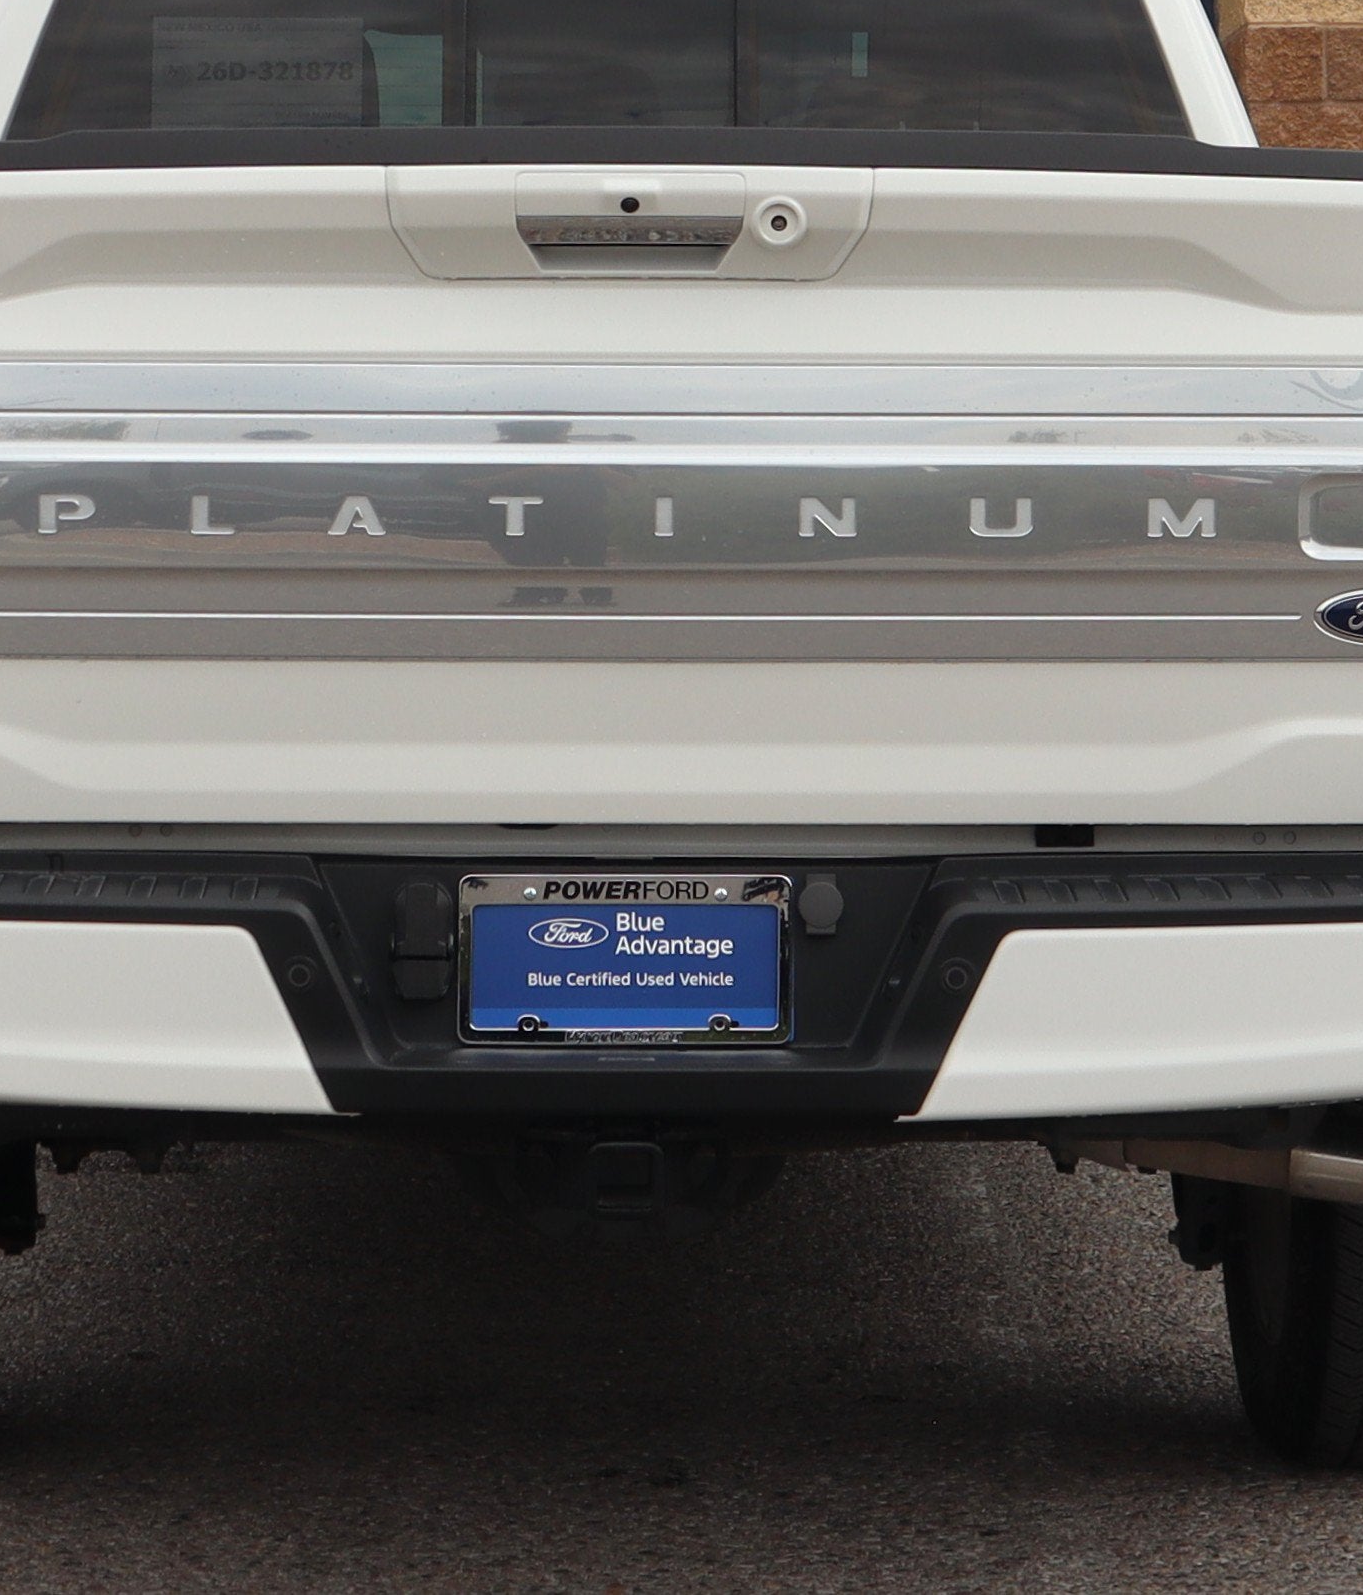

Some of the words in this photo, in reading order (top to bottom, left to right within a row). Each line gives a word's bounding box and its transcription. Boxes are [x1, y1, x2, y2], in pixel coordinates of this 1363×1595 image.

[196, 60, 354, 82] 26D-321878
[38, 494, 1217, 539] PLATINUM
[542, 880, 709, 900] POWERFORD
[615, 912, 665, 933] Blue
[543, 923, 593, 945] Ford
[615, 935, 734, 959] Advantage
[527, 971, 562, 987] Blue
[566, 971, 631, 987] Certified
[635, 971, 674, 987] Used
[679, 971, 735, 987] Vehicle
